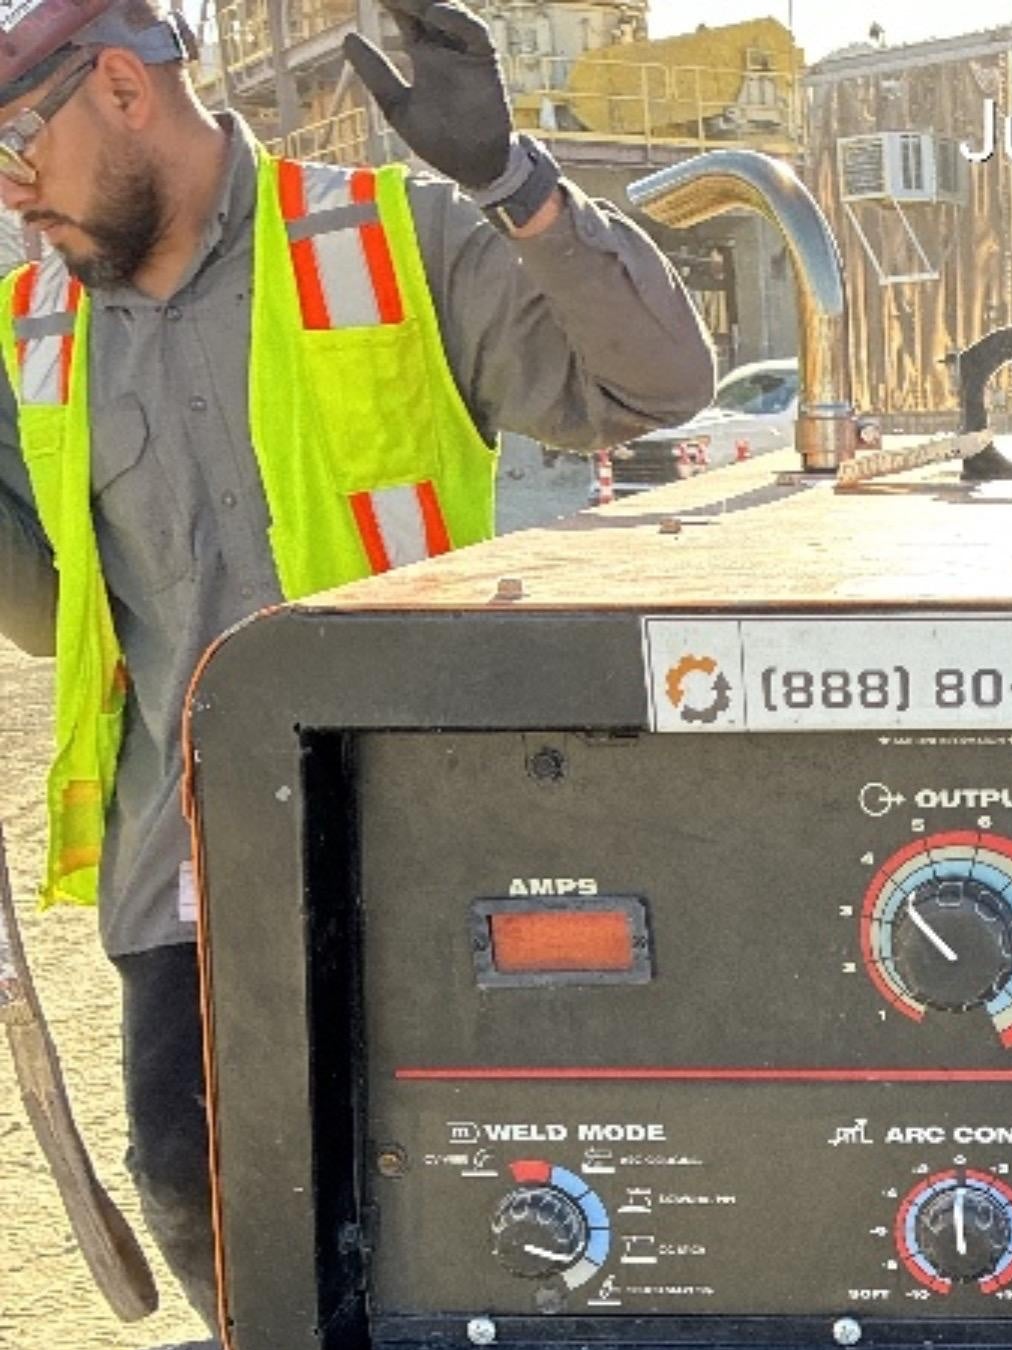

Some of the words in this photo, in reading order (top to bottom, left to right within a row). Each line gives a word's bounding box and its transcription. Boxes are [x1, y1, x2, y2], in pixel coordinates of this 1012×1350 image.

[761, 666, 911, 712] (888)
[508, 878, 598, 896] AMPS
[482, 1123, 568, 1142] WELD
[578, 1123, 667, 1142] MODE
[884, 1126, 946, 1145] ARC
